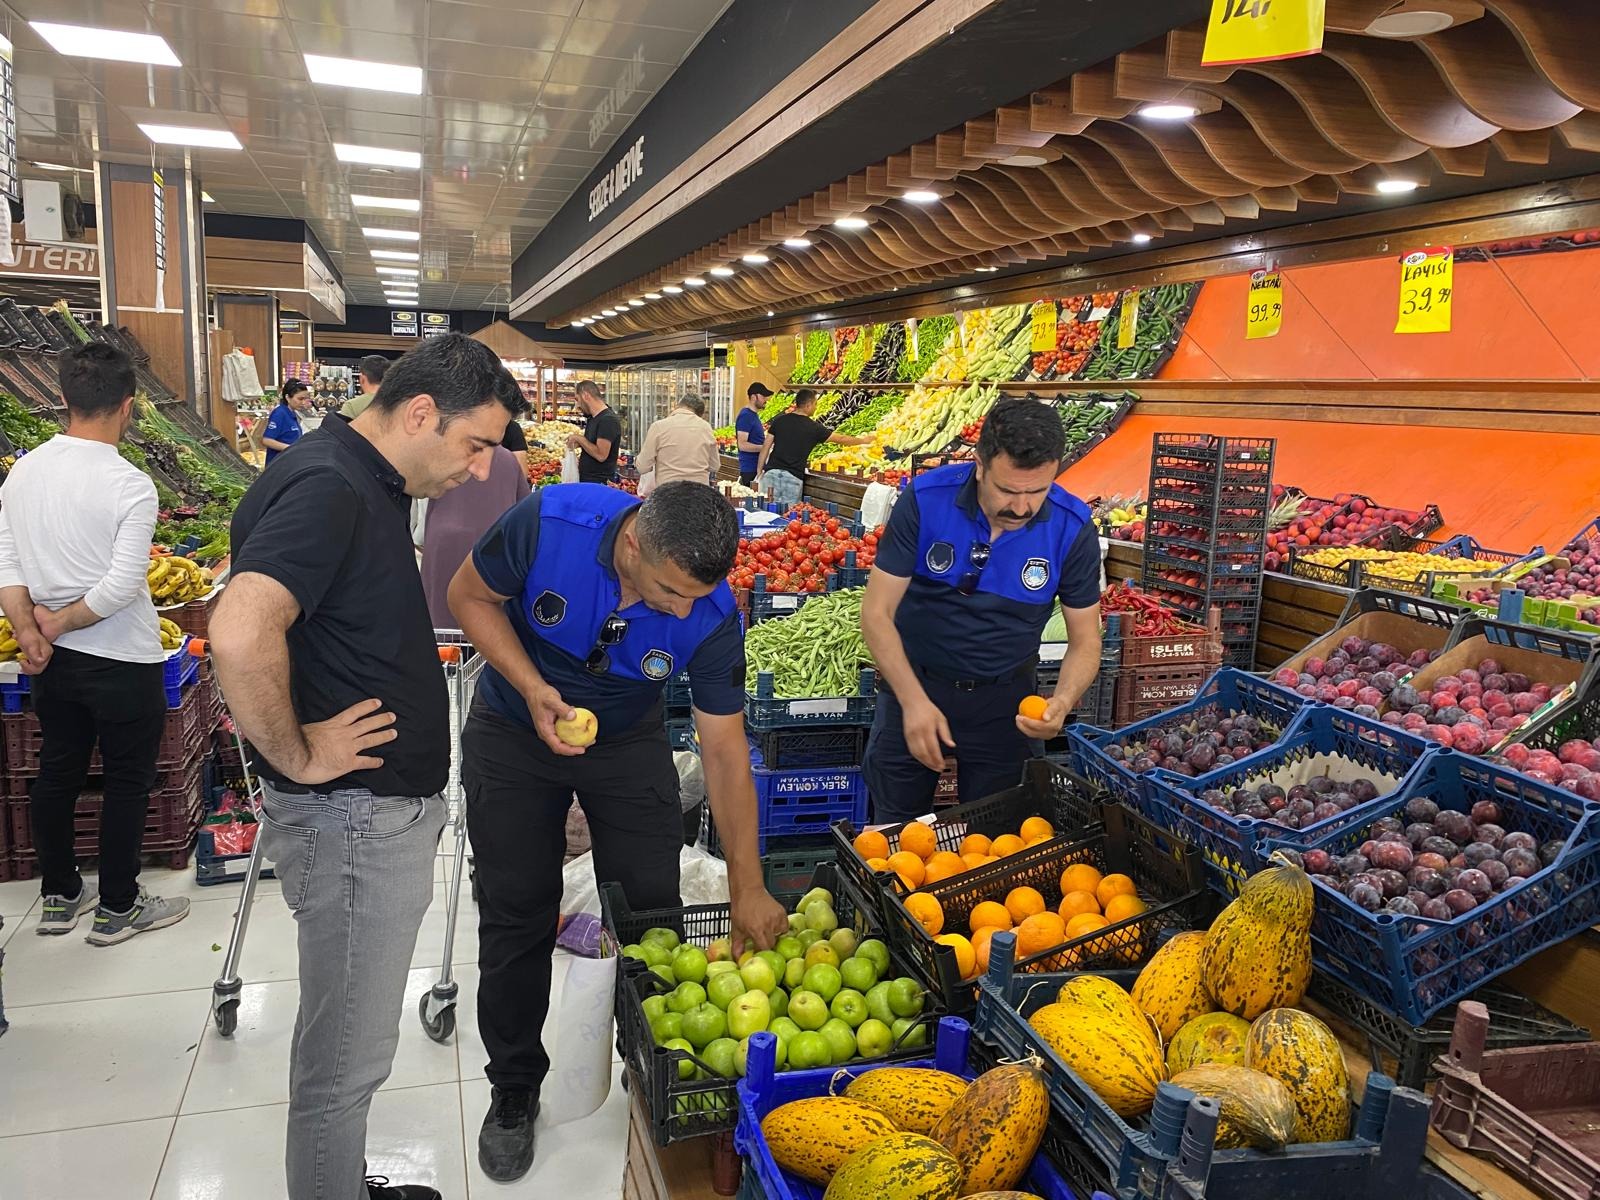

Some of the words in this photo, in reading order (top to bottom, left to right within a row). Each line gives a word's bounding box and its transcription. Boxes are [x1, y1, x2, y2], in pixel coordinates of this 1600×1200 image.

[588, 174, 610, 222] SEBZE
[614, 136, 645, 199] MEYVE
[1404, 262, 1447, 282] KAYISI
